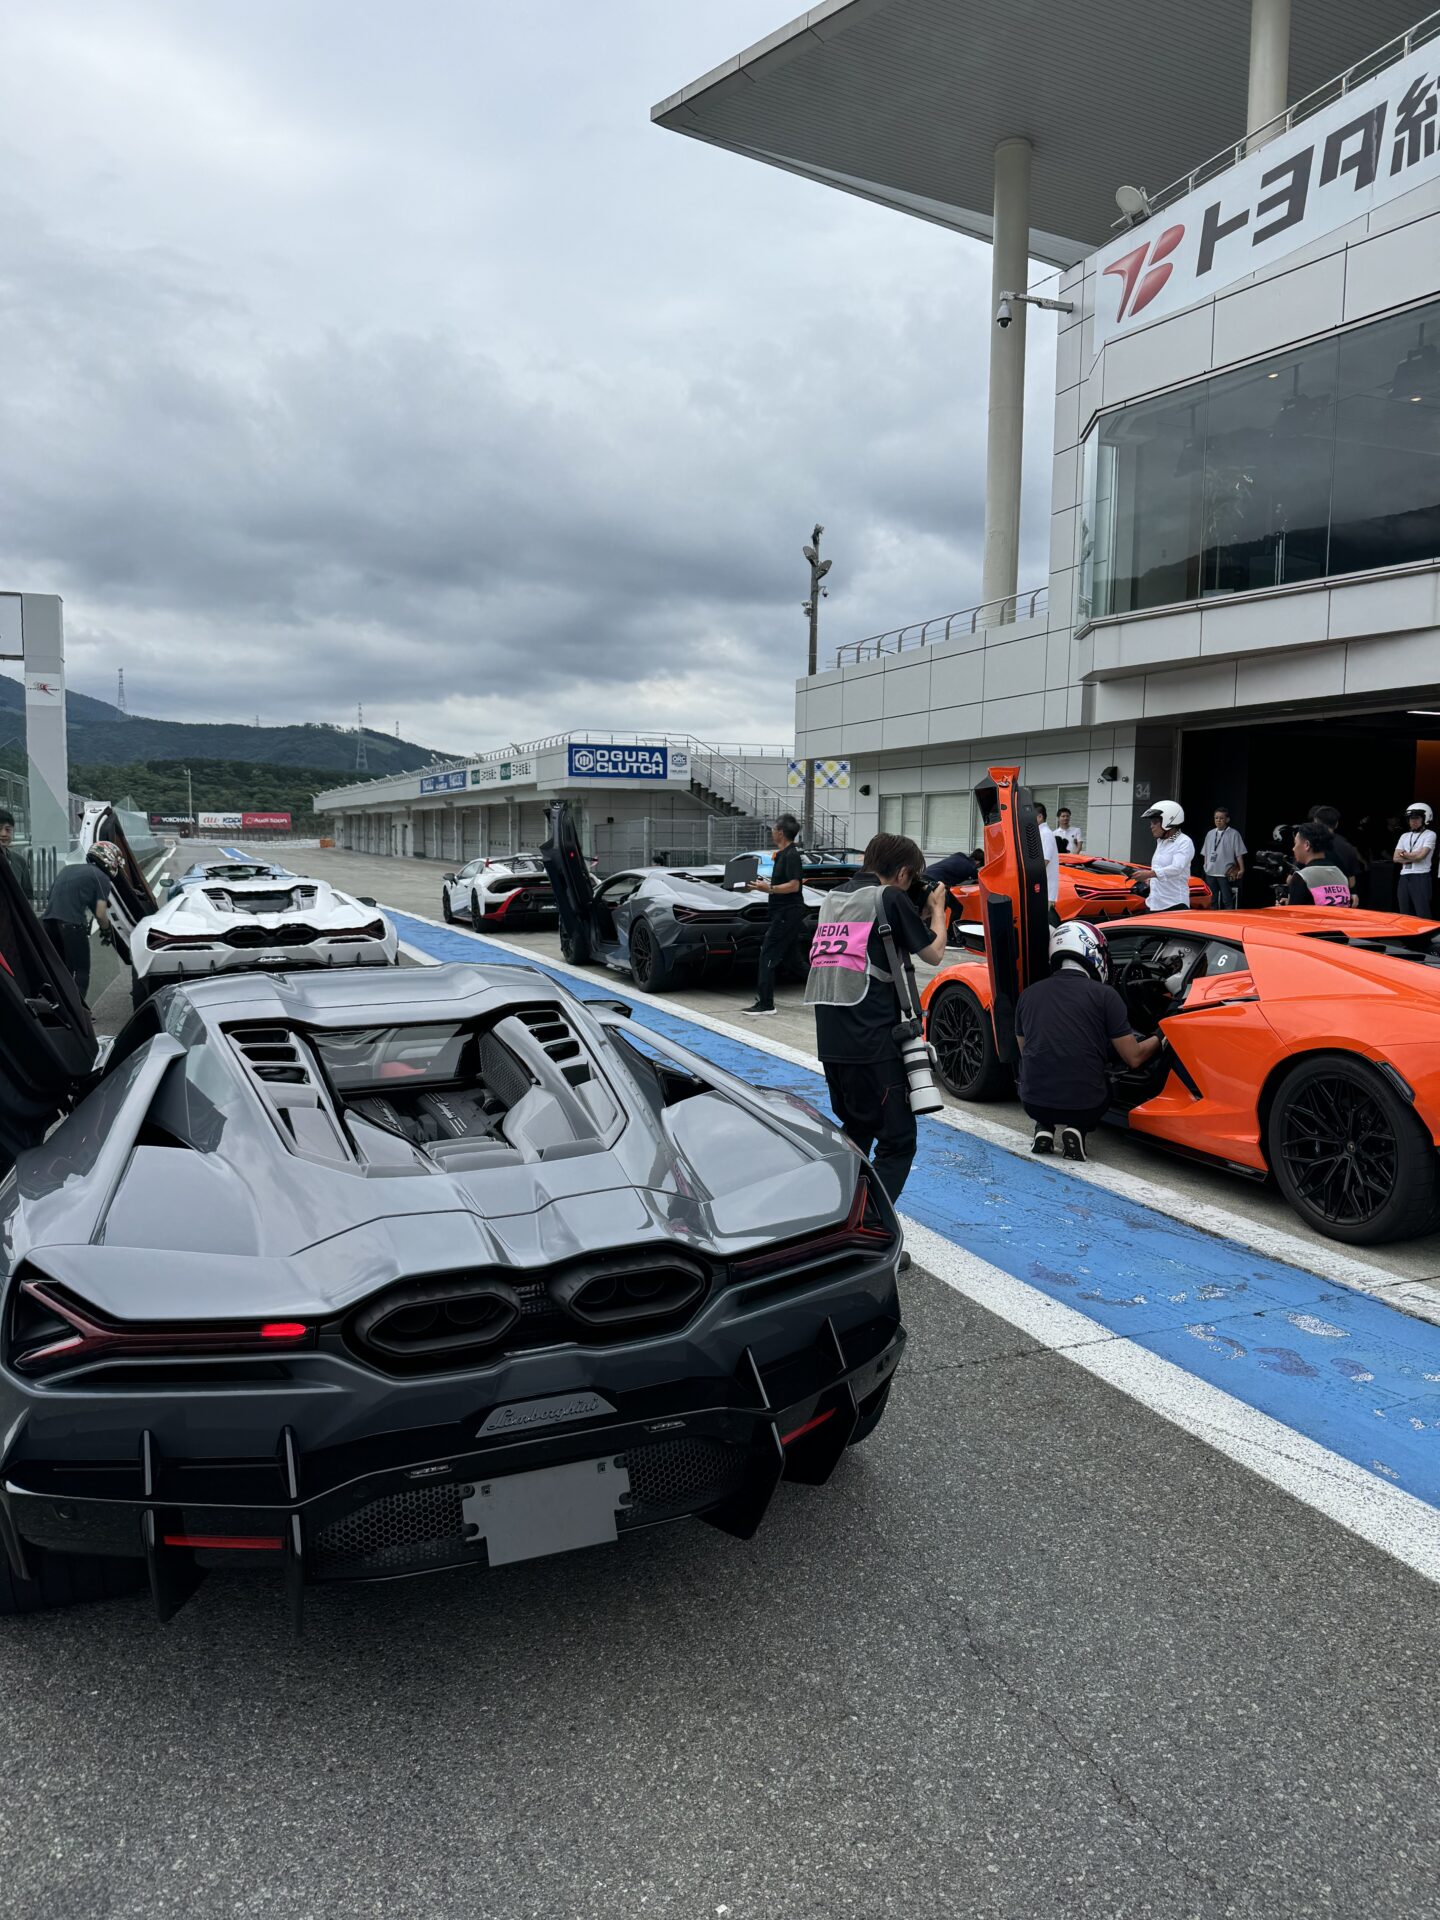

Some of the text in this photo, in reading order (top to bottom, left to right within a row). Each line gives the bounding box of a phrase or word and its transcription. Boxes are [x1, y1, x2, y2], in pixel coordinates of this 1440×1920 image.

[596, 750, 663, 763] OGURA
[596, 762, 663, 774] CLUTCH
[1135, 783, 1150, 799] 34
[1217, 954, 1228, 967] 6
[486, 1397, 599, 1431] Lamborghini
